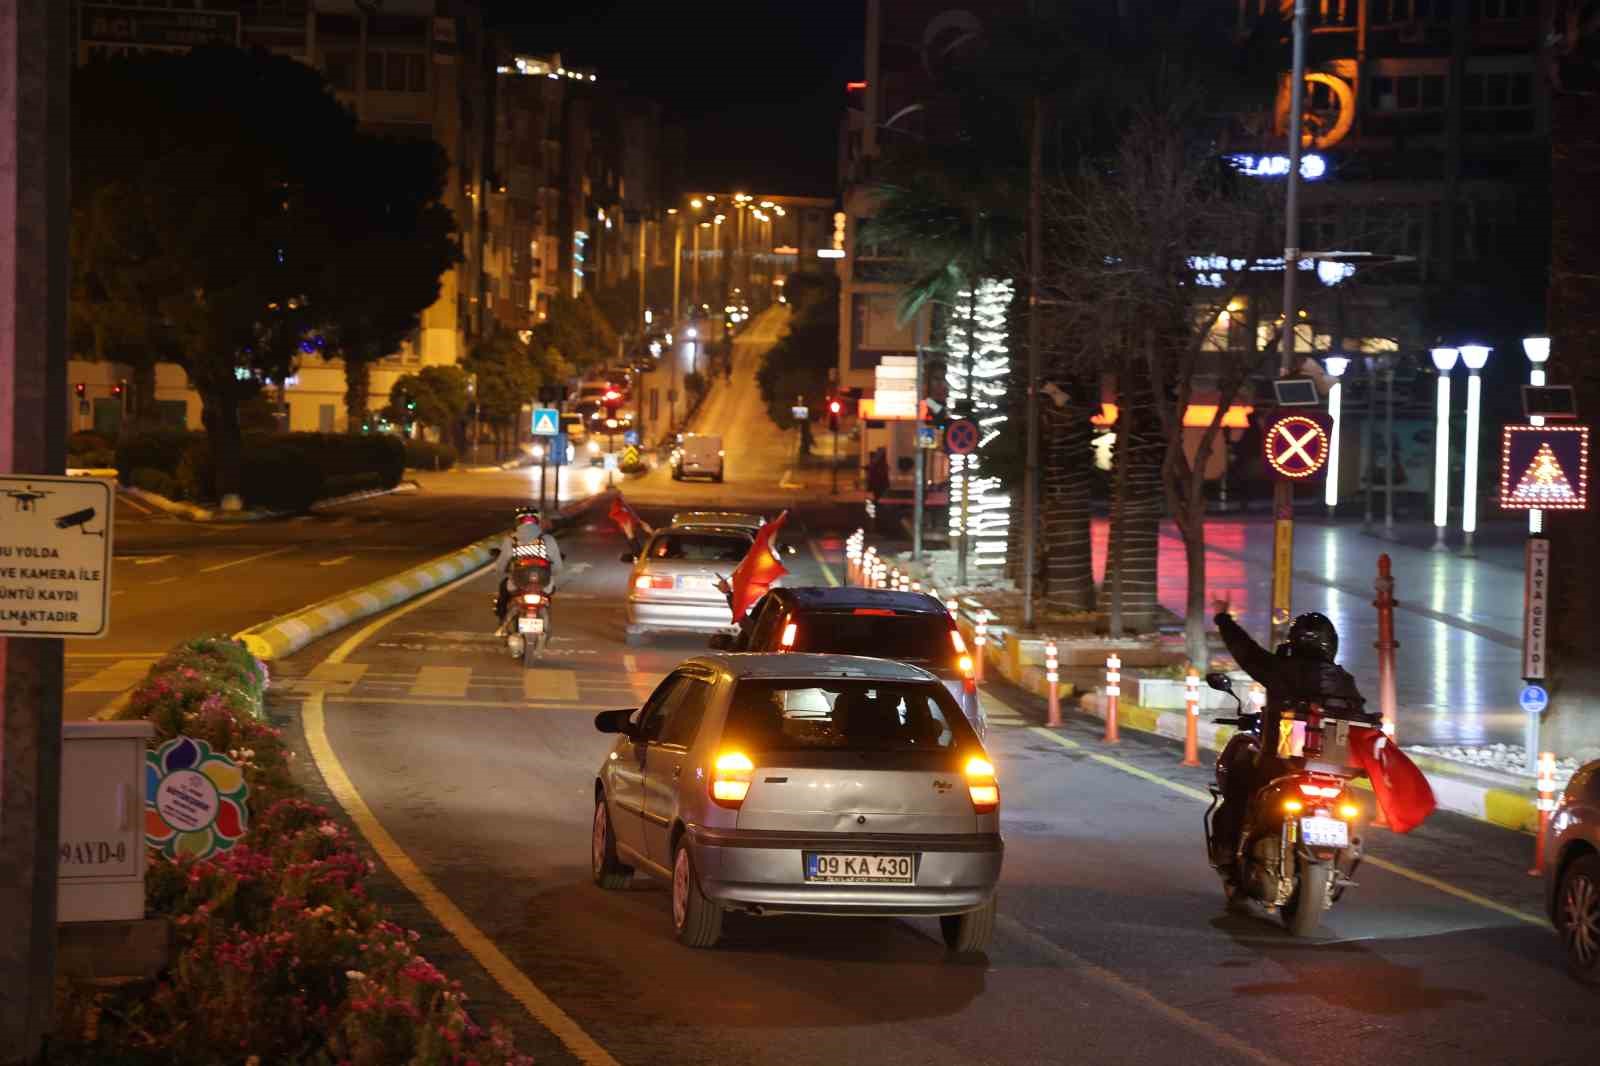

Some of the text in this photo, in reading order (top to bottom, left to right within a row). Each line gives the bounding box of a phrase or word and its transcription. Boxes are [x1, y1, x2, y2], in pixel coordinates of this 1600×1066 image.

[16, 547, 59, 558] YOLDA
[20, 568, 77, 580] KAMERA
[79, 567, 100, 581] İLE
[1533, 557, 1546, 600] YAYA
[38, 589, 79, 601] KAYDI
[58, 841, 126, 864] 9AYD-0
[817, 857, 909, 876] 09 KA 430
